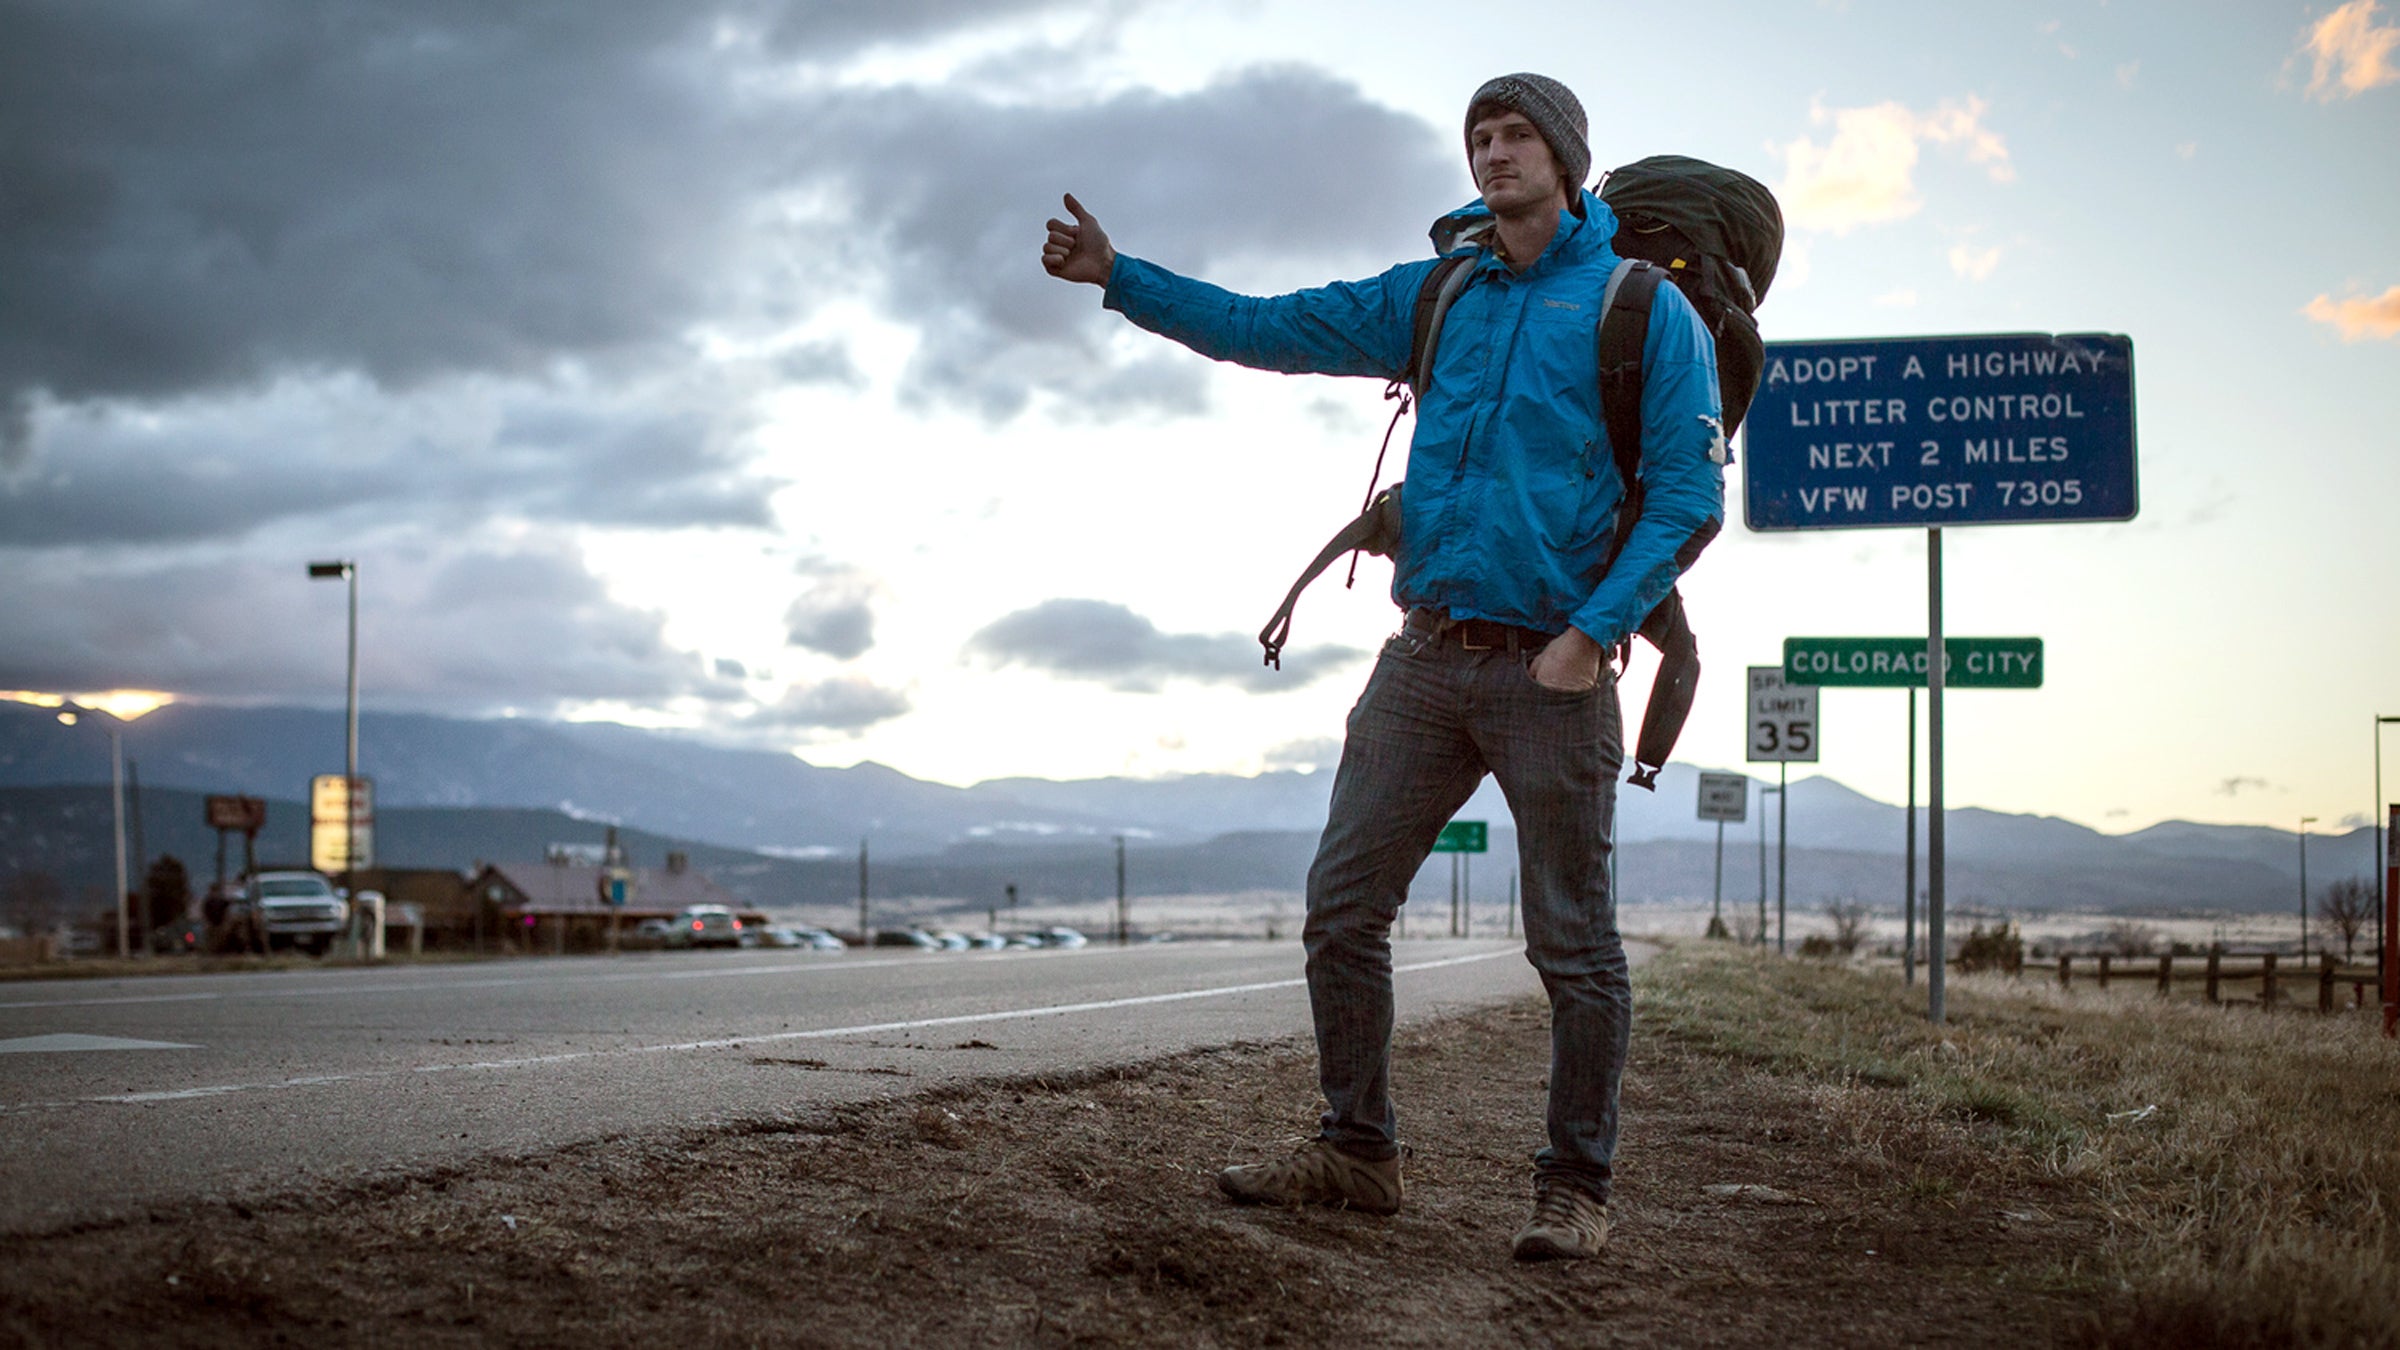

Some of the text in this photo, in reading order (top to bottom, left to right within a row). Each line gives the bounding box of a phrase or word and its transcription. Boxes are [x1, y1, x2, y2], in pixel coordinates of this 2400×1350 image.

[1767, 350, 2106, 384] ADOPT A HIGHWAY
[1791, 394, 2085, 426] LITTER CONTROL
[1809, 438, 2069, 469] NEXT 2 MILES
[1799, 480, 2083, 513] VFW POST 7305
[1966, 651, 2038, 674] CITY
[1758, 697, 1808, 714] LIMIT
[1757, 720, 1812, 754] 35
